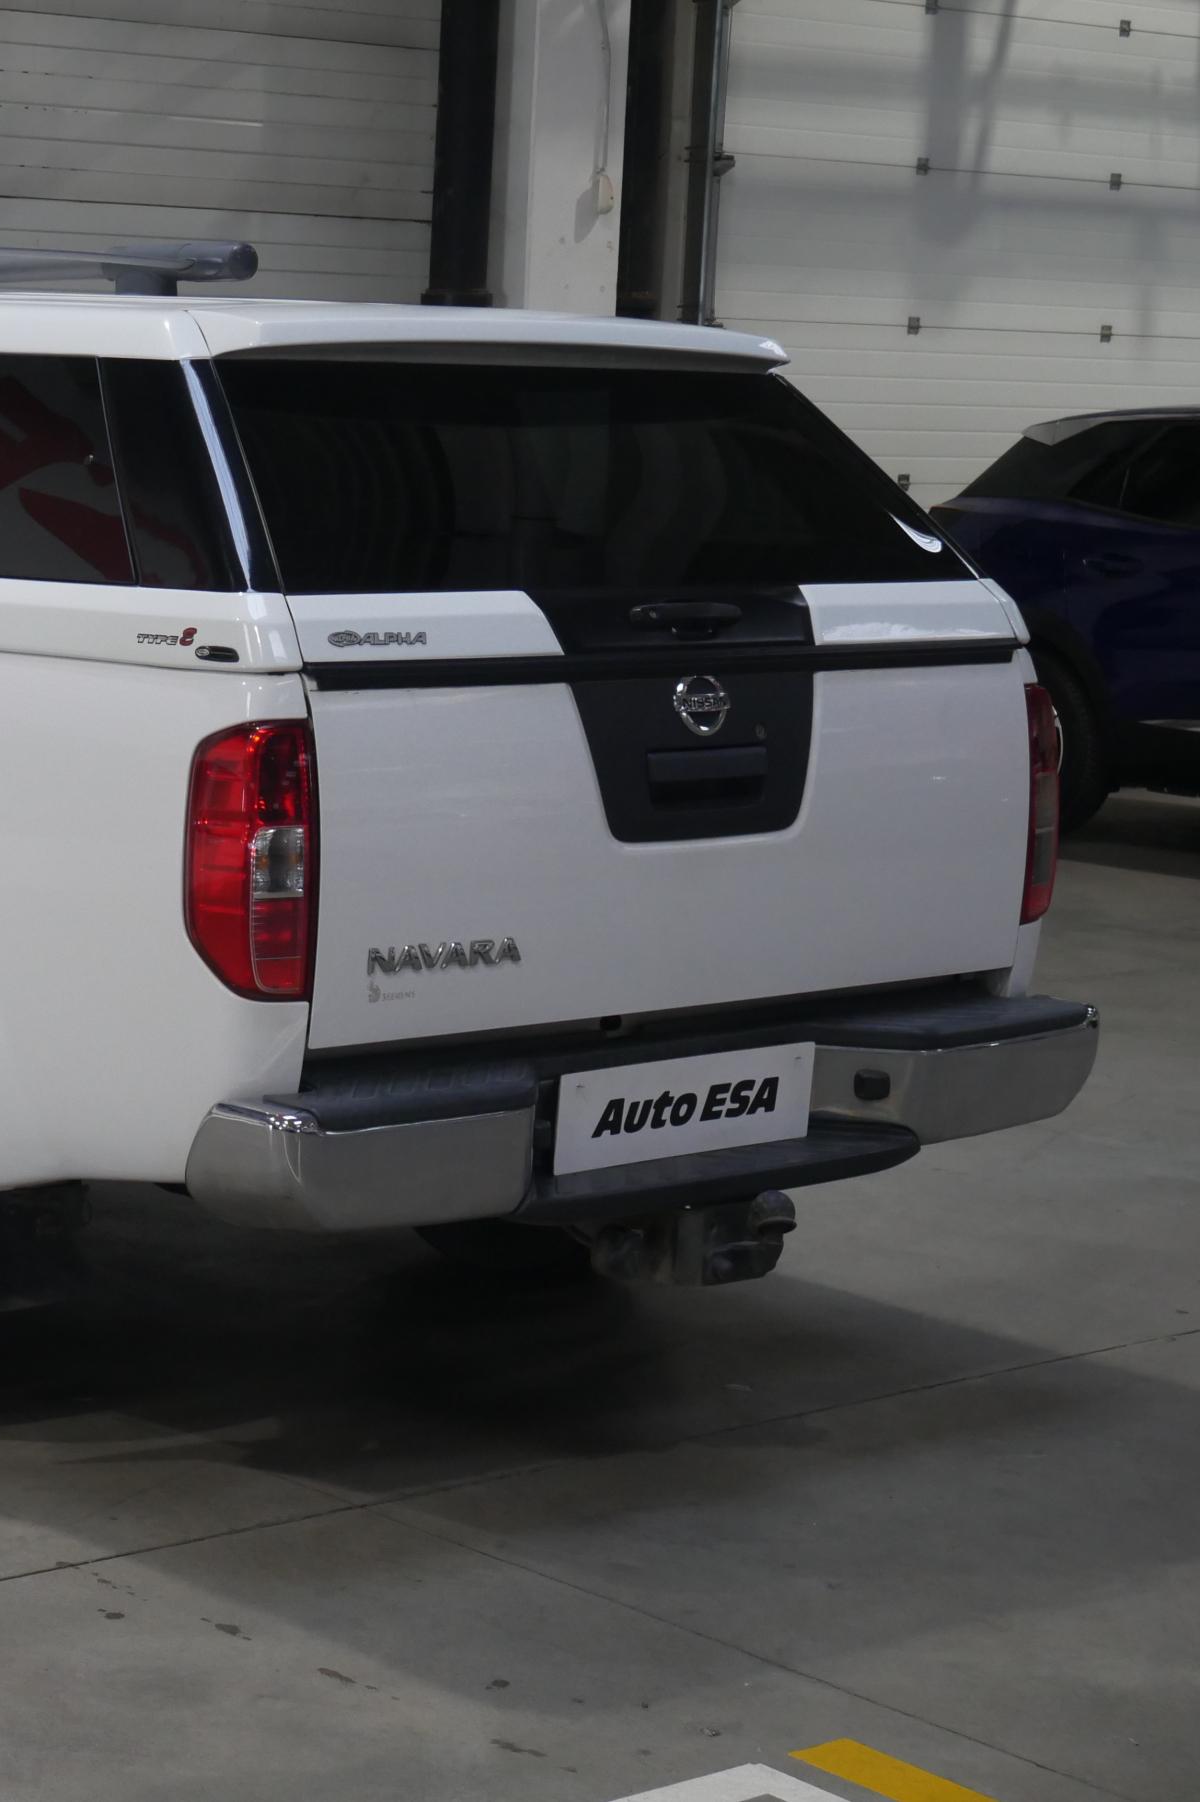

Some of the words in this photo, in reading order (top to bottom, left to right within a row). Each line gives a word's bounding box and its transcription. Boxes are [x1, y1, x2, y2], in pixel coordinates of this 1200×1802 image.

[136, 633, 179, 646] TYPE
[358, 631, 427, 646] ALPHA
[367, 937, 522, 976] NAVARA
[591, 1090, 698, 1139] Auto
[699, 1076, 780, 1122] ESA
